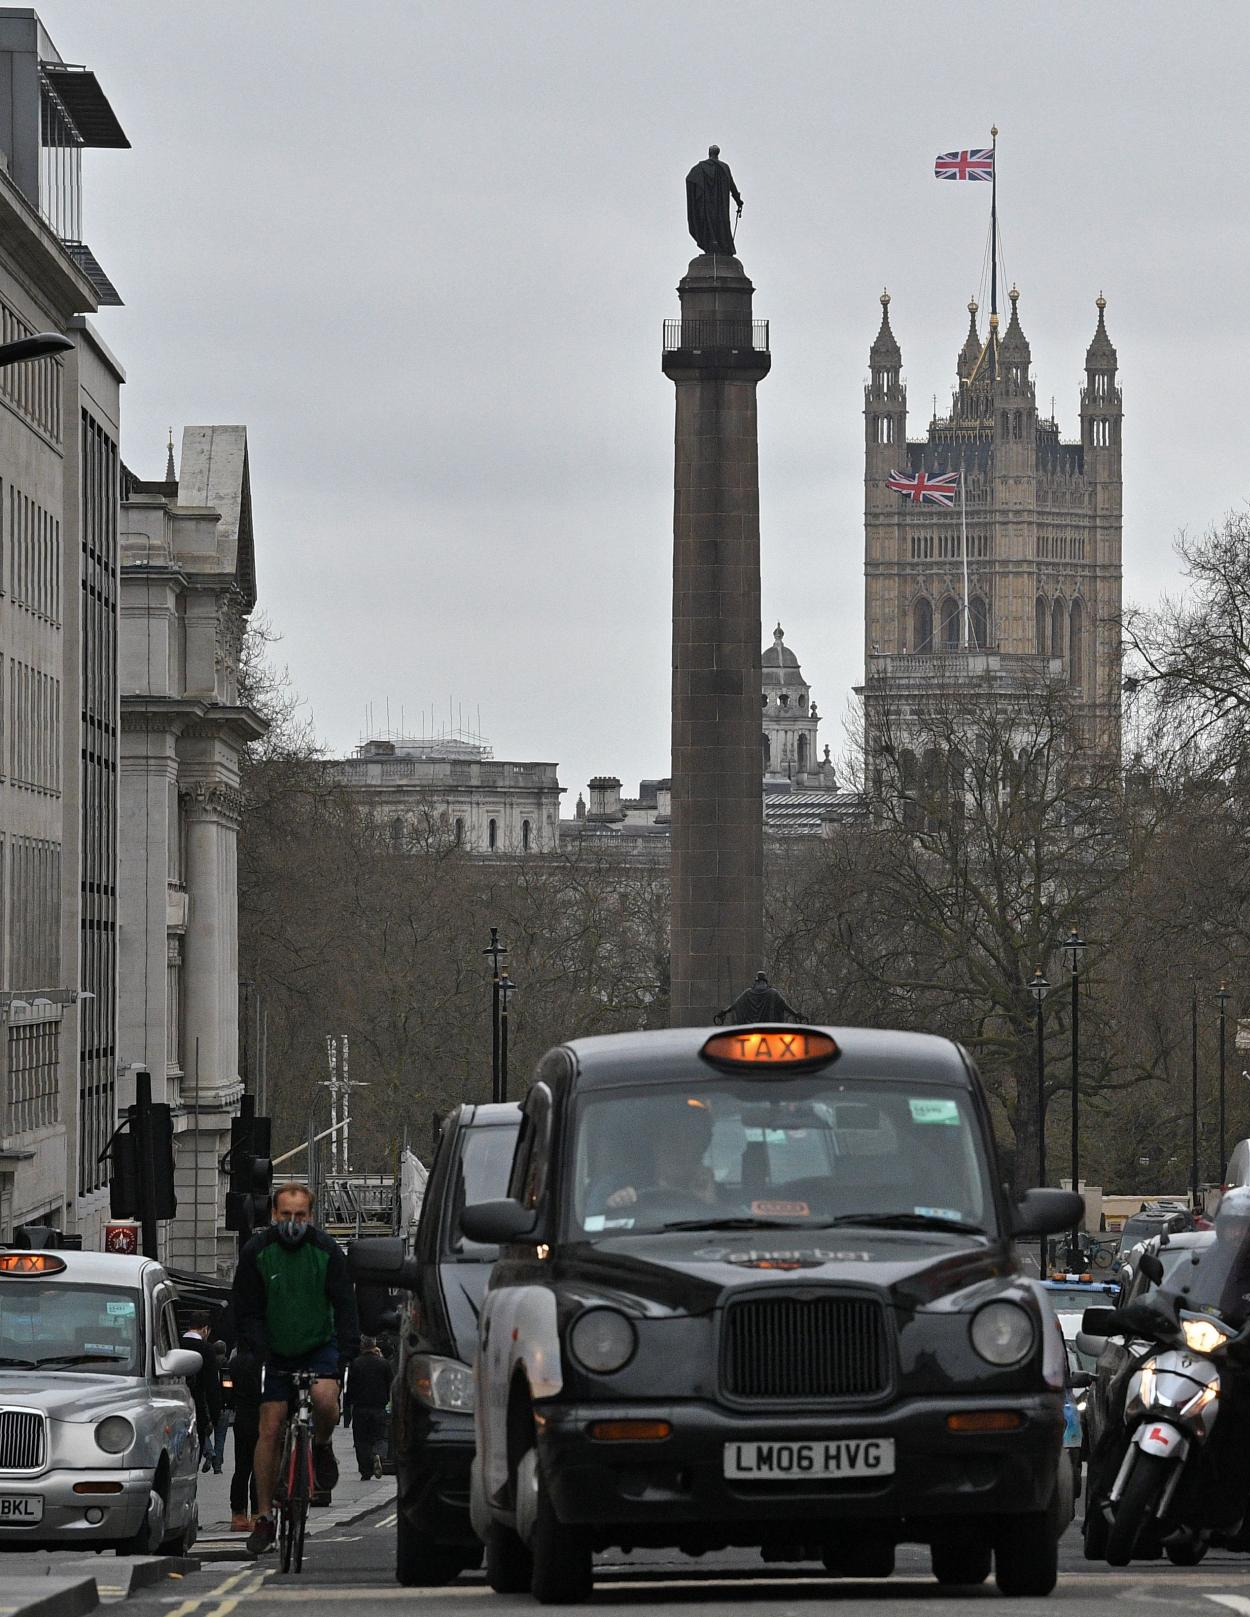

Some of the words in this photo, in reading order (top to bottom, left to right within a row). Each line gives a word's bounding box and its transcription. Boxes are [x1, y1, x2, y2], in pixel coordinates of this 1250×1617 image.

[736, 1036, 810, 1057] TAXI
[823, 1442, 881, 1471] HVG
[1, 1500, 35, 1516] BKL
